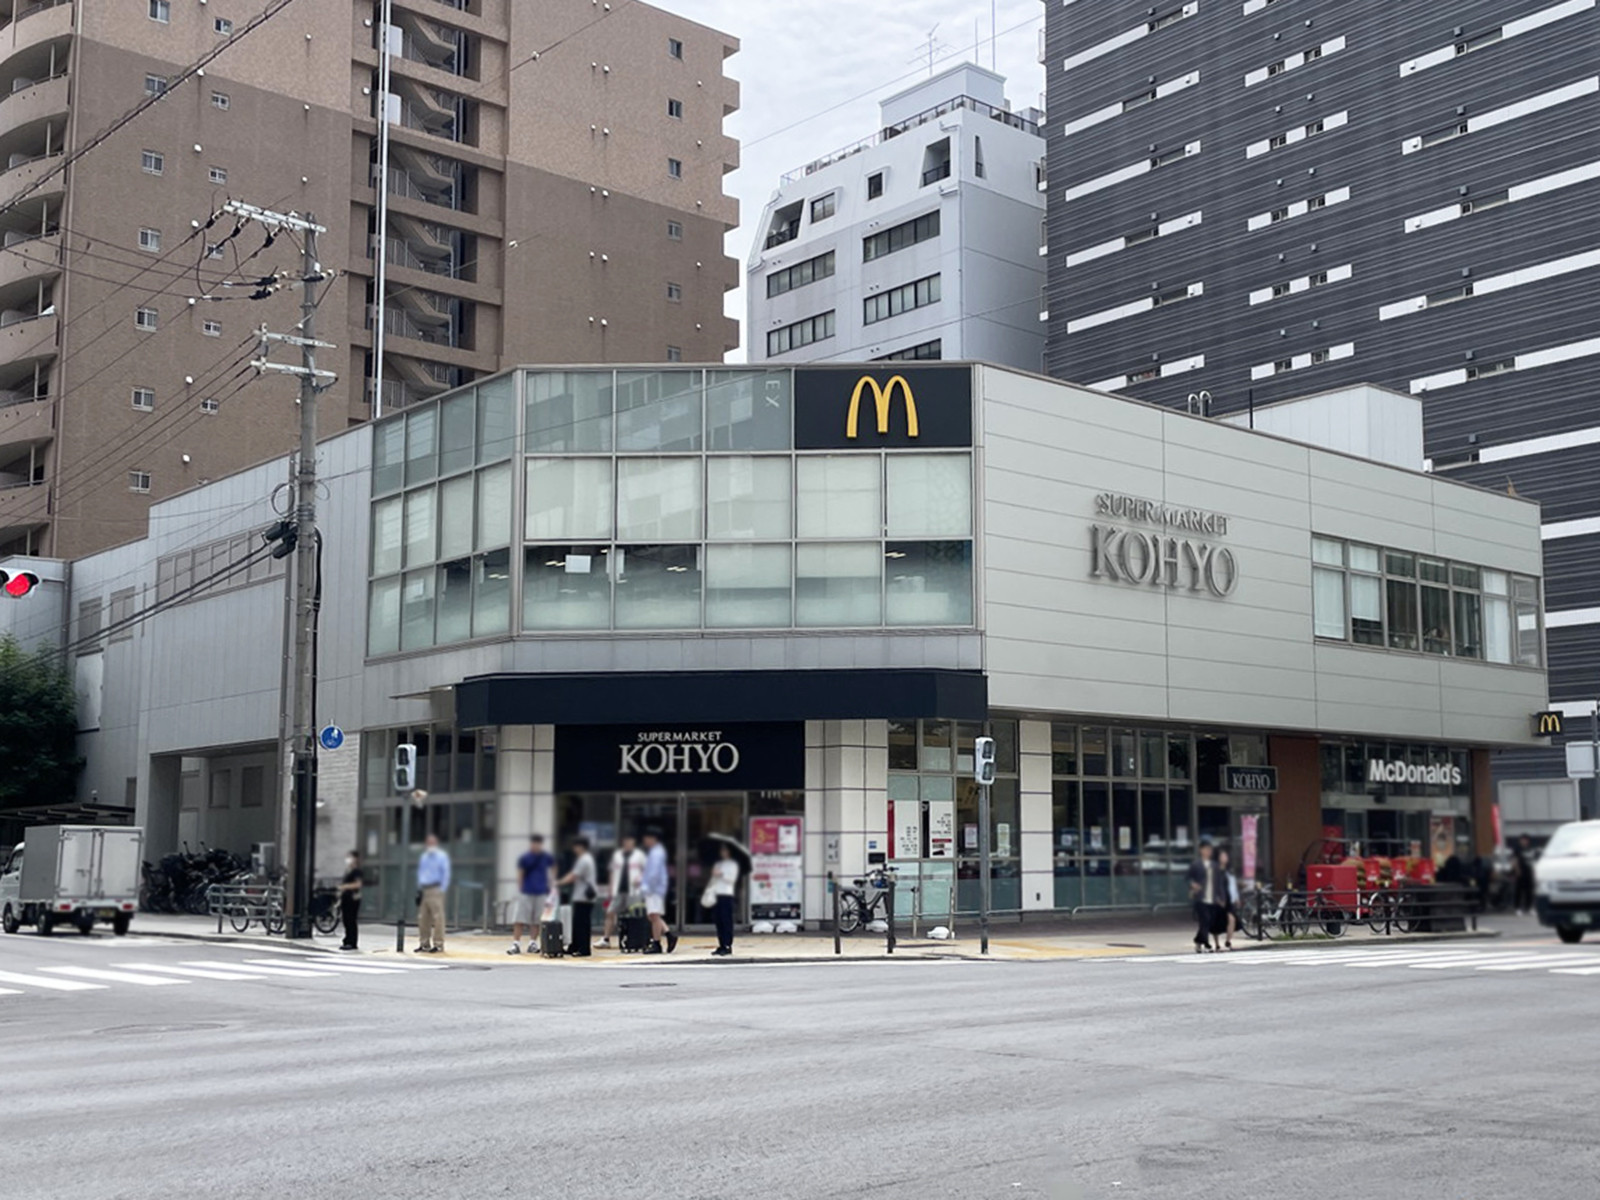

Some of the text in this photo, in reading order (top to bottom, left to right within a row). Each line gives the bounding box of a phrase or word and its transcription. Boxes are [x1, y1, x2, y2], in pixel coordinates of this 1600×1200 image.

[1089, 524, 1238, 597] KOHYO
[637, 731, 722, 742] SUPERMARKET
[618, 742, 739, 774] KOHYO
[1369, 758, 1462, 785] McDonald's
[1232, 773, 1270, 790] KOHYO
